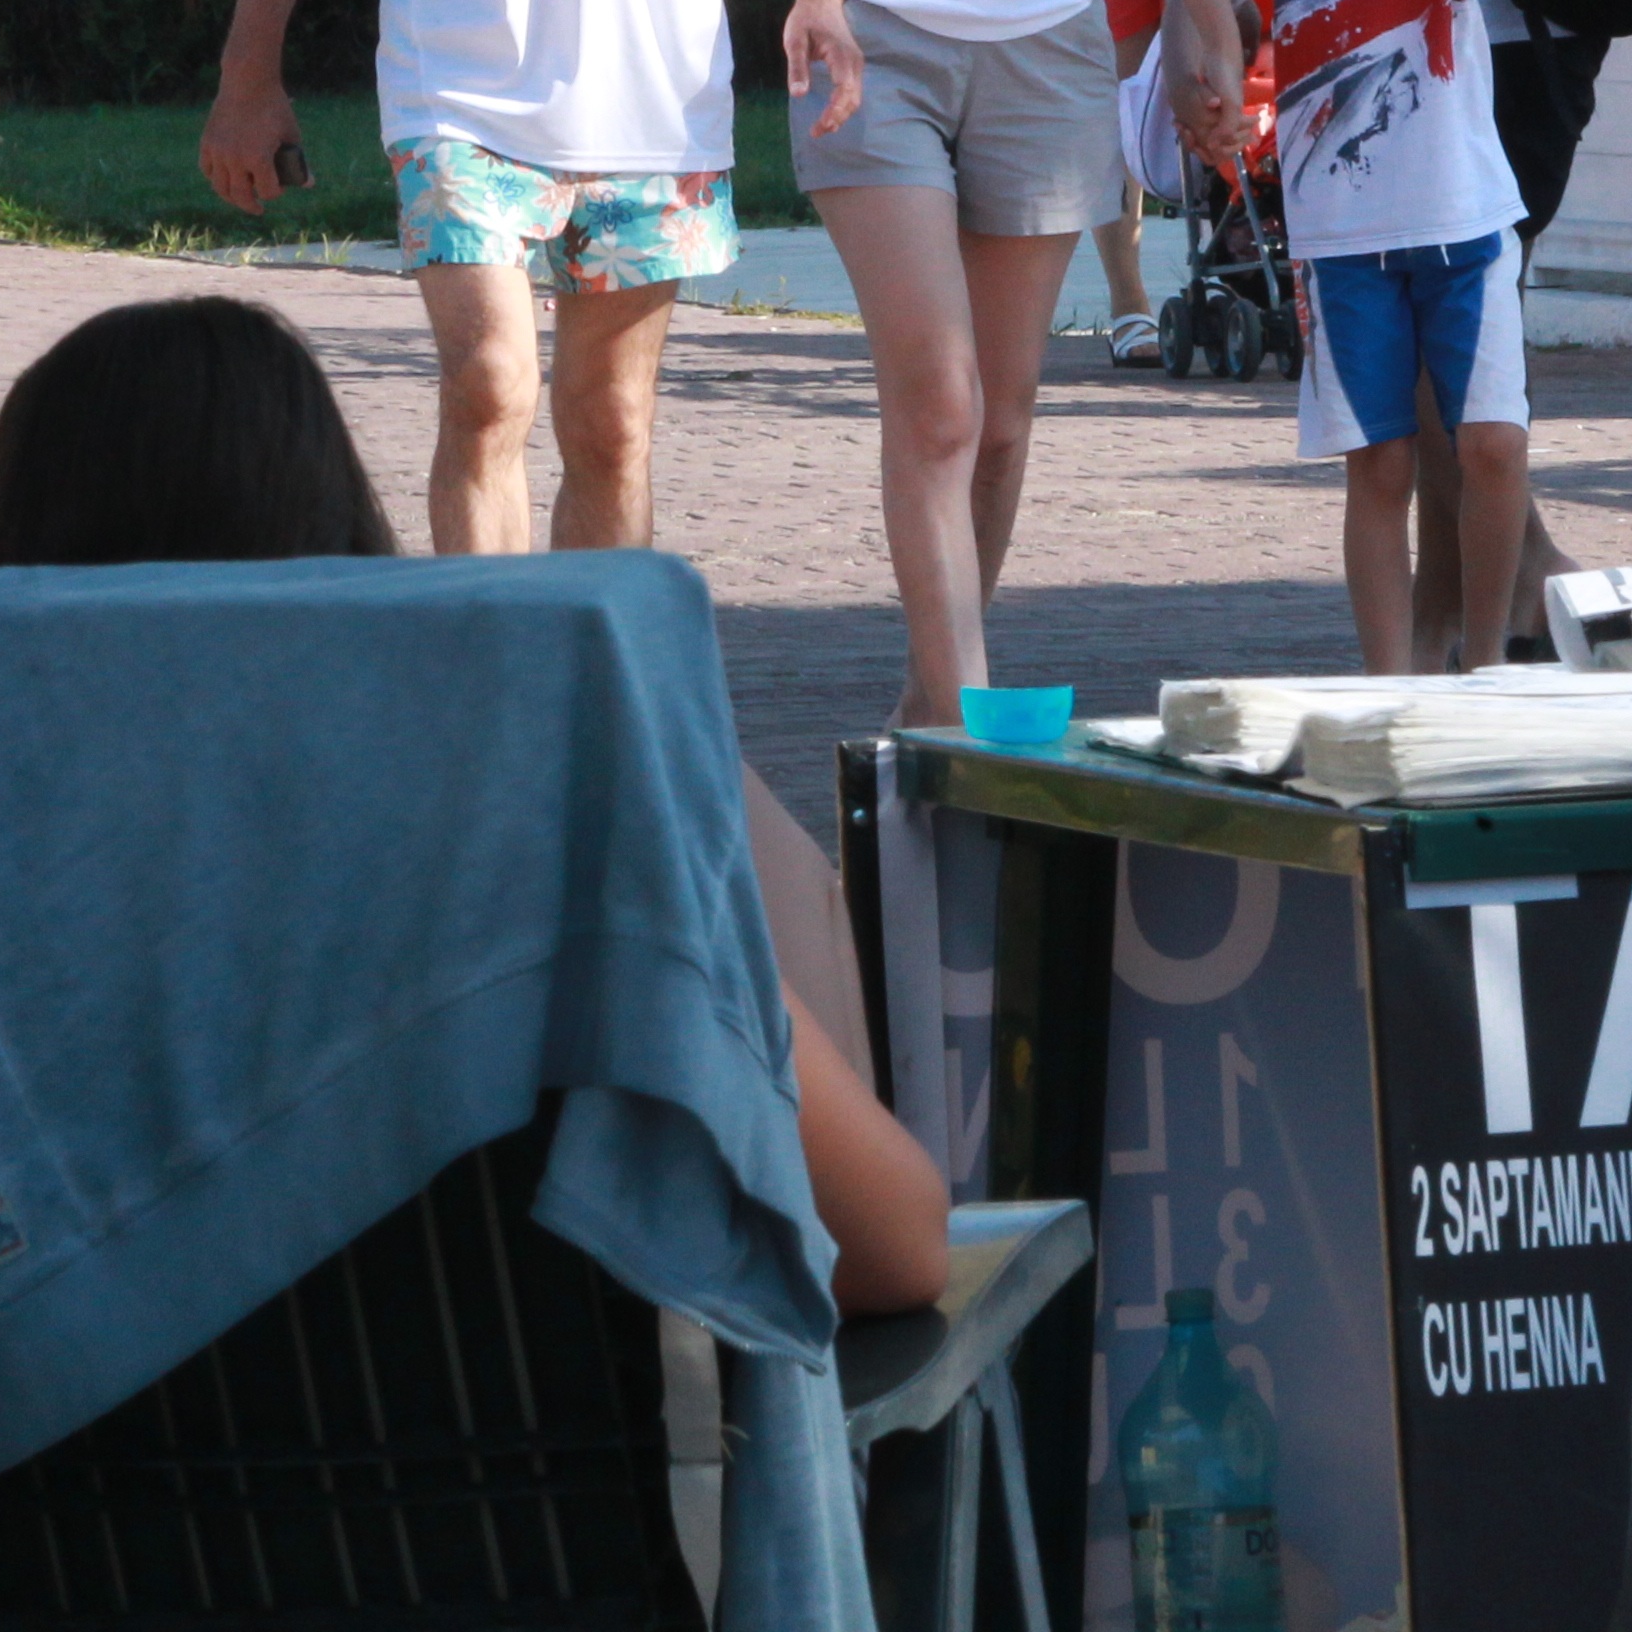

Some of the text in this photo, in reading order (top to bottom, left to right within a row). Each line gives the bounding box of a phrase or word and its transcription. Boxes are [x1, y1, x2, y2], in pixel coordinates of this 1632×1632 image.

[1411, 1165, 1435, 1257] 2
[1423, 1292, 1607, 1398] CU HENNA
